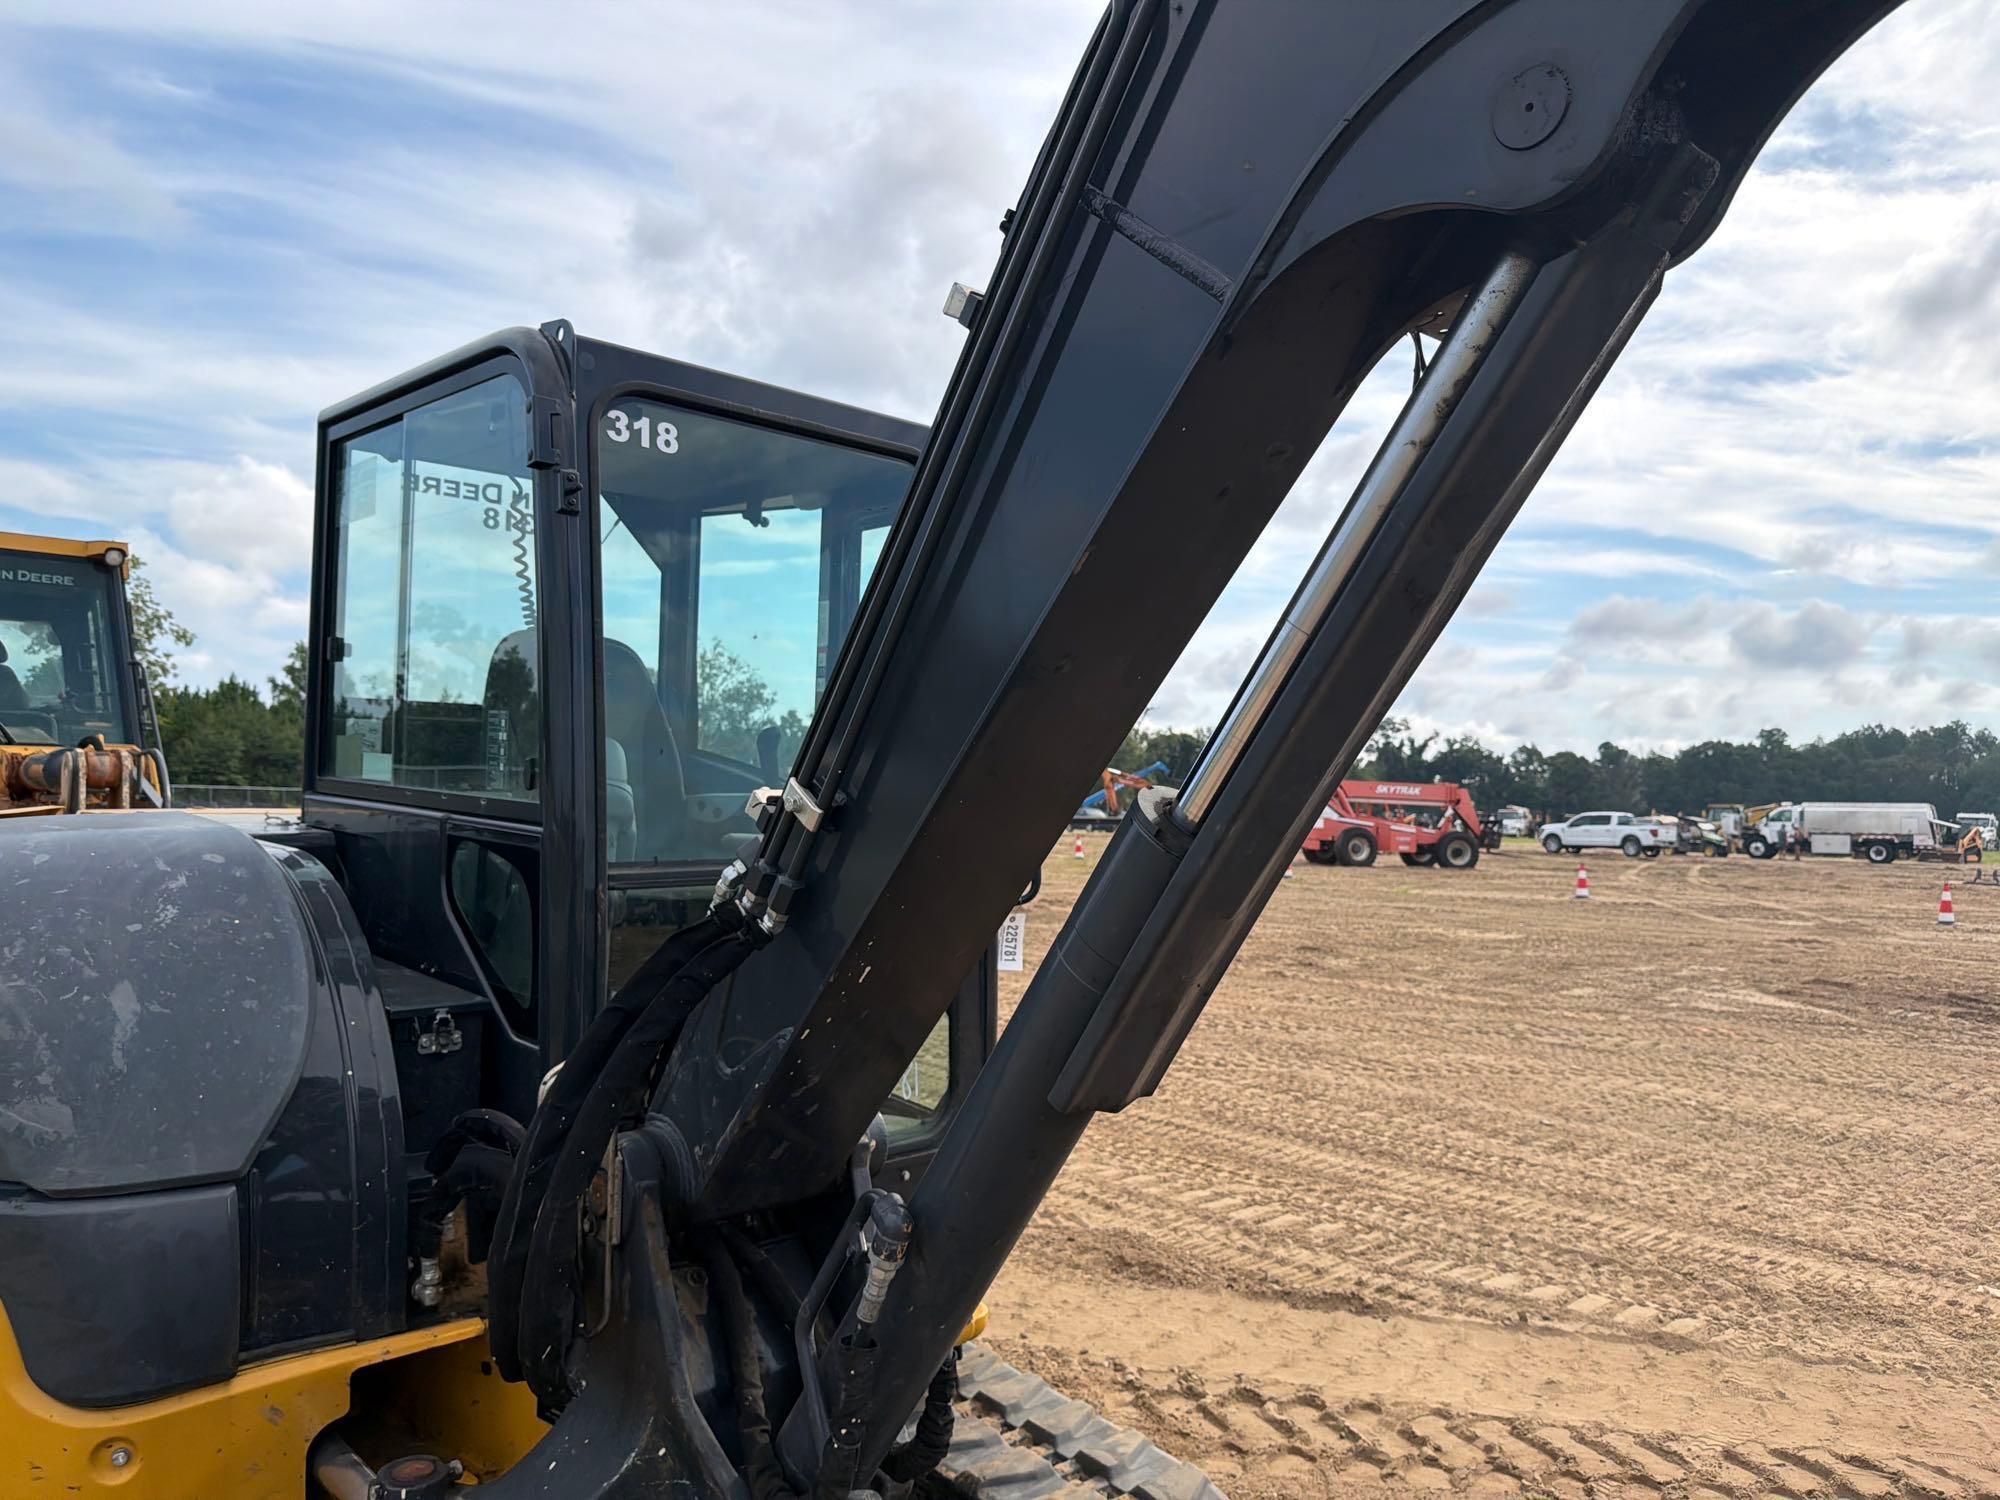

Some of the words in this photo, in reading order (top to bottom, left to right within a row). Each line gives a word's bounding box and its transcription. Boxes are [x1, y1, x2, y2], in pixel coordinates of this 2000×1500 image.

[606, 409, 679, 454] 318
[17, 569, 75, 586] DEERE
[1375, 784, 1421, 796] SKYTRAK
[1003, 924, 1019, 962] 225781
